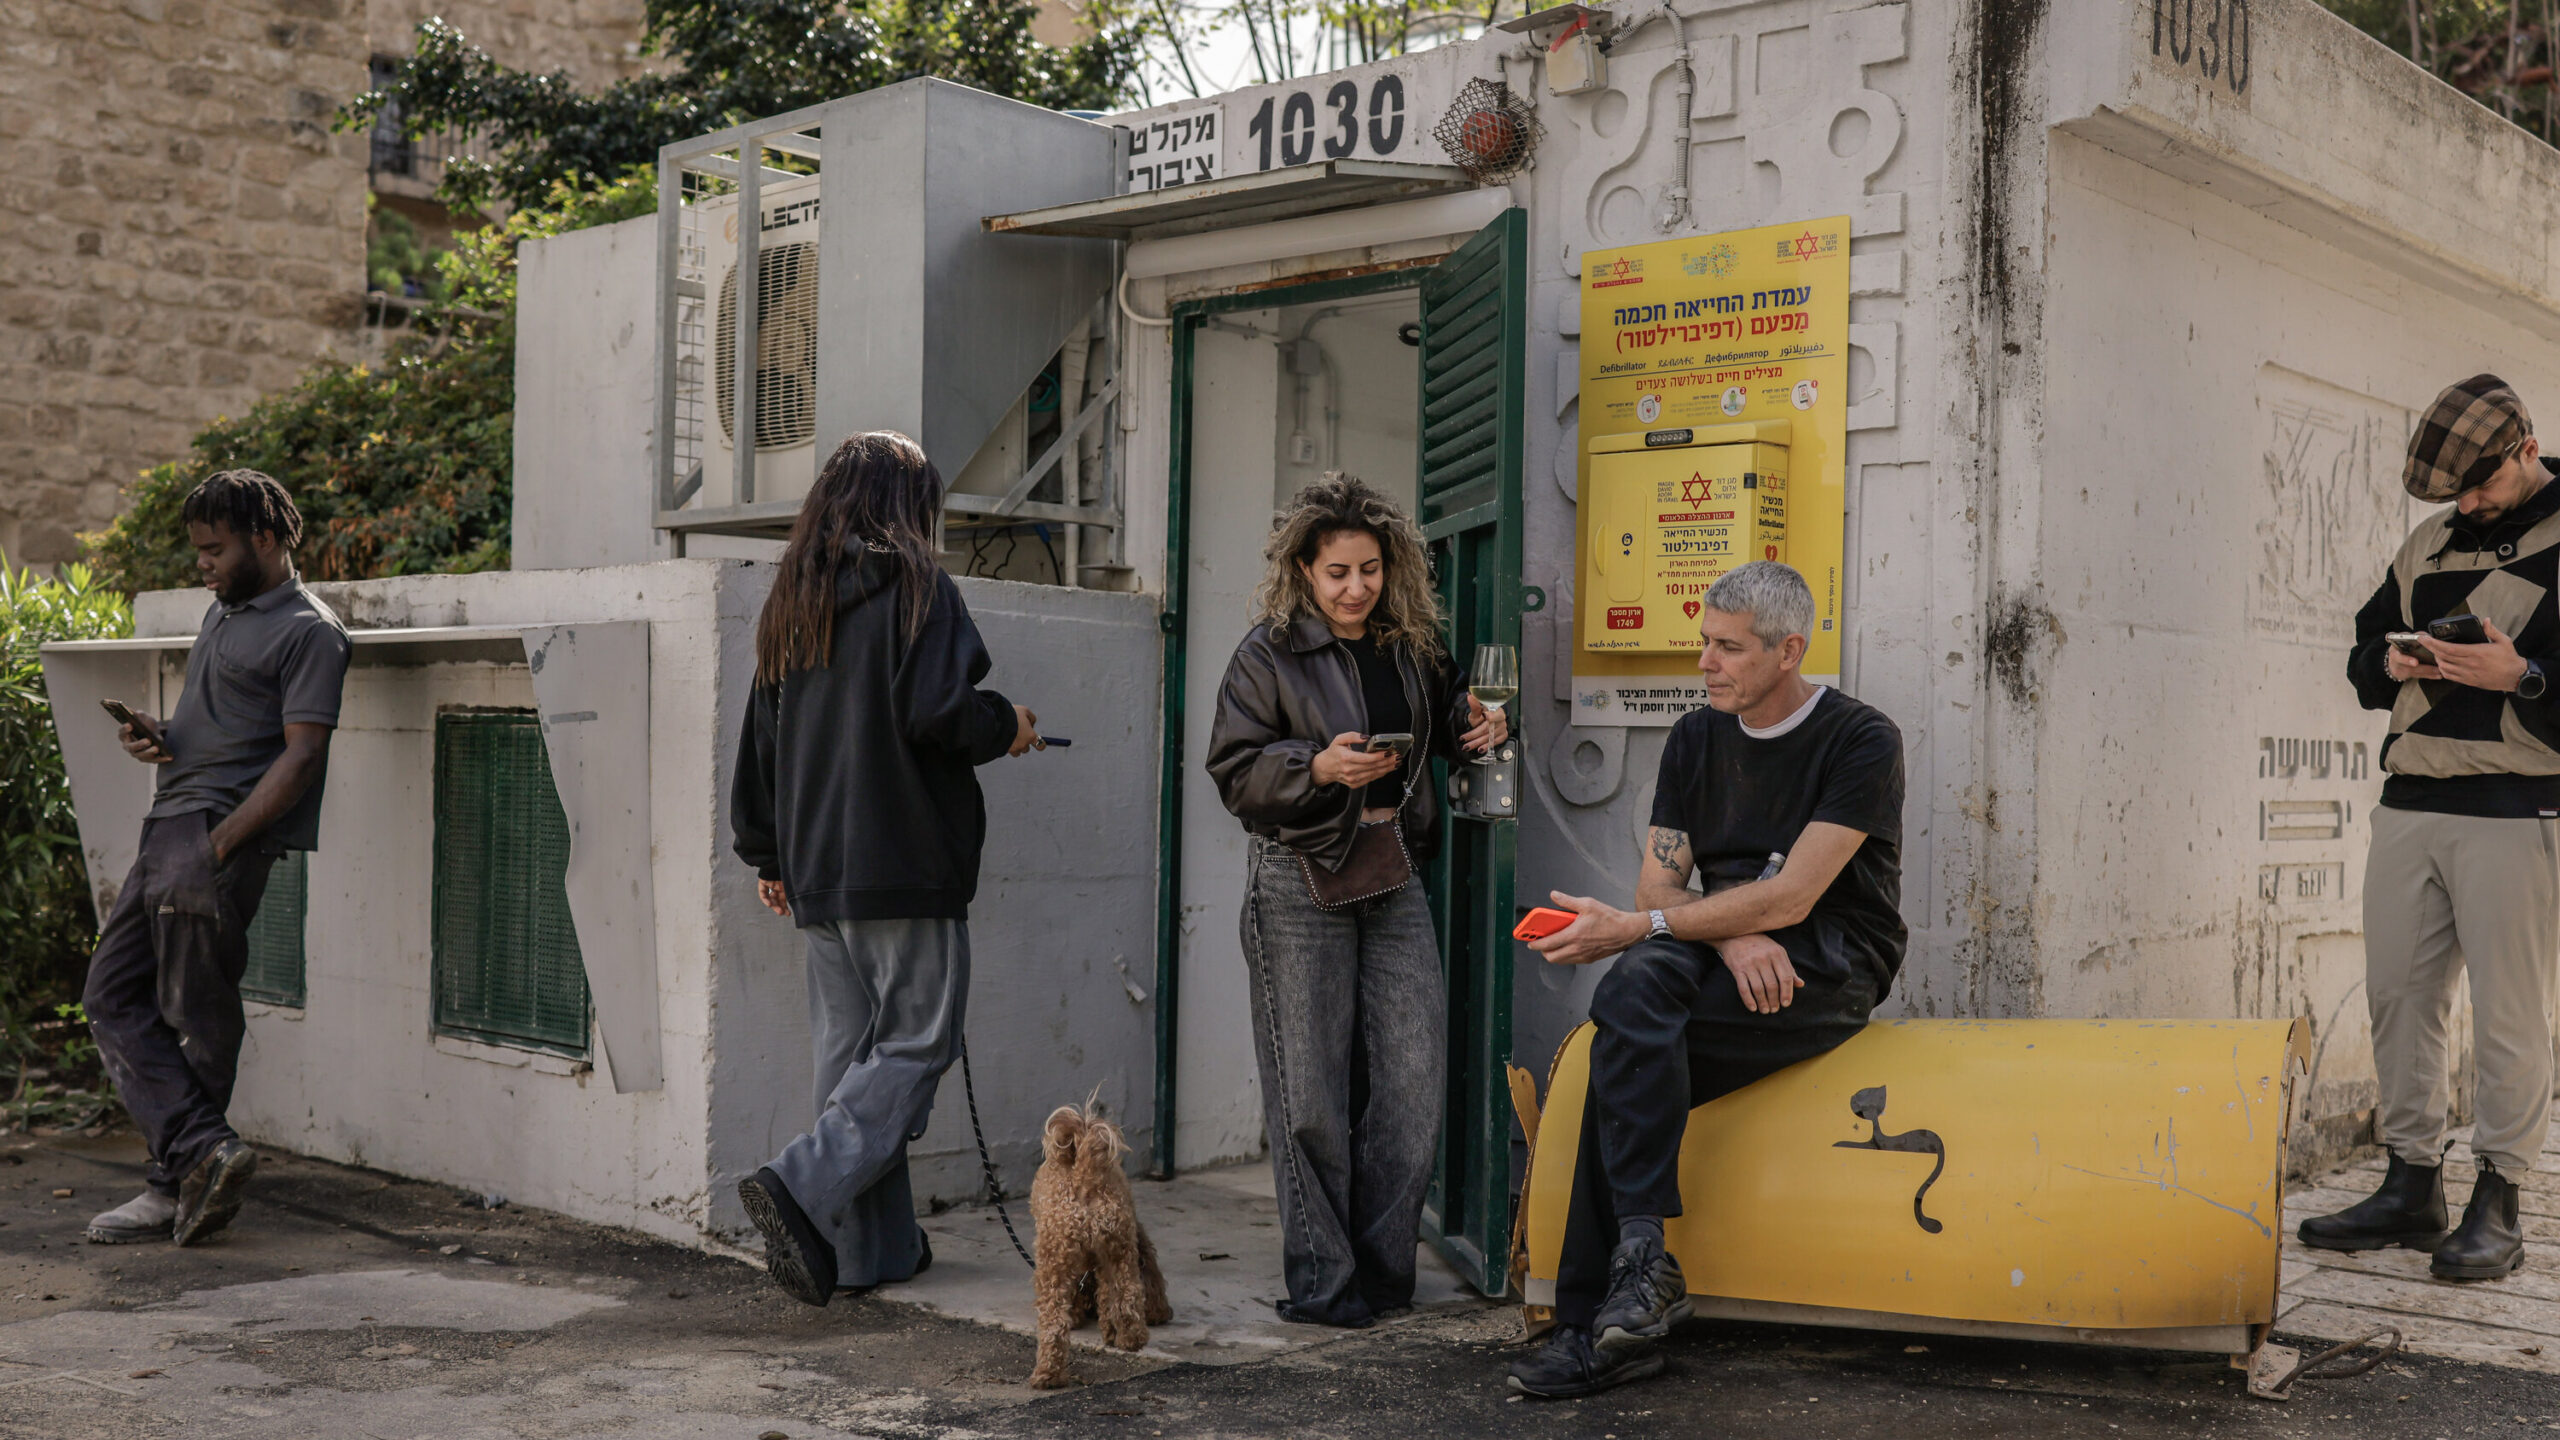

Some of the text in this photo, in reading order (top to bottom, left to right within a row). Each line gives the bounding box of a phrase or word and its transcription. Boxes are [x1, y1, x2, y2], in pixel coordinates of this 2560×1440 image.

[1249, 74, 1404, 171] 1030
[1129, 113, 1214, 156] מקלט
[761, 198, 820, 232] LECT
[1614, 286, 1811, 326] עמדת החייאה חכמה
[1616, 316, 1743, 354] (דפיברילטור)
[1704, 349, 1769, 364] Дефибрилятор
[1600, 361, 1647, 374] Defibrillator
[1636, 366, 1783, 391] מצילים חיים בשלושה צעדים
[1761, 495, 1783, 506] מכשיר
[1713, 512, 1731, 520] ארגון
[1760, 506, 1784, 518] החייאה
[1664, 528, 1728, 538] מכשיר החייאה
[1662, 540, 1728, 552] דפיברילטור
[1690, 558, 1717, 567] לפתיחת
[1666, 584, 1710, 595] ייגו 101
[1628, 609, 1641, 617] ארון
[1616, 619, 1634, 627] 1749
[1616, 689, 1646, 698] הציבור
[1649, 687, 1682, 698] לרווחת
[1685, 689, 1698, 698] יפו
[1624, 701, 1637, 712] ז"ל
[1640, 703, 1664, 714] זוסמן
[1668, 703, 1687, 713] אורן
[2259, 736, 2368, 780] תרשישה
